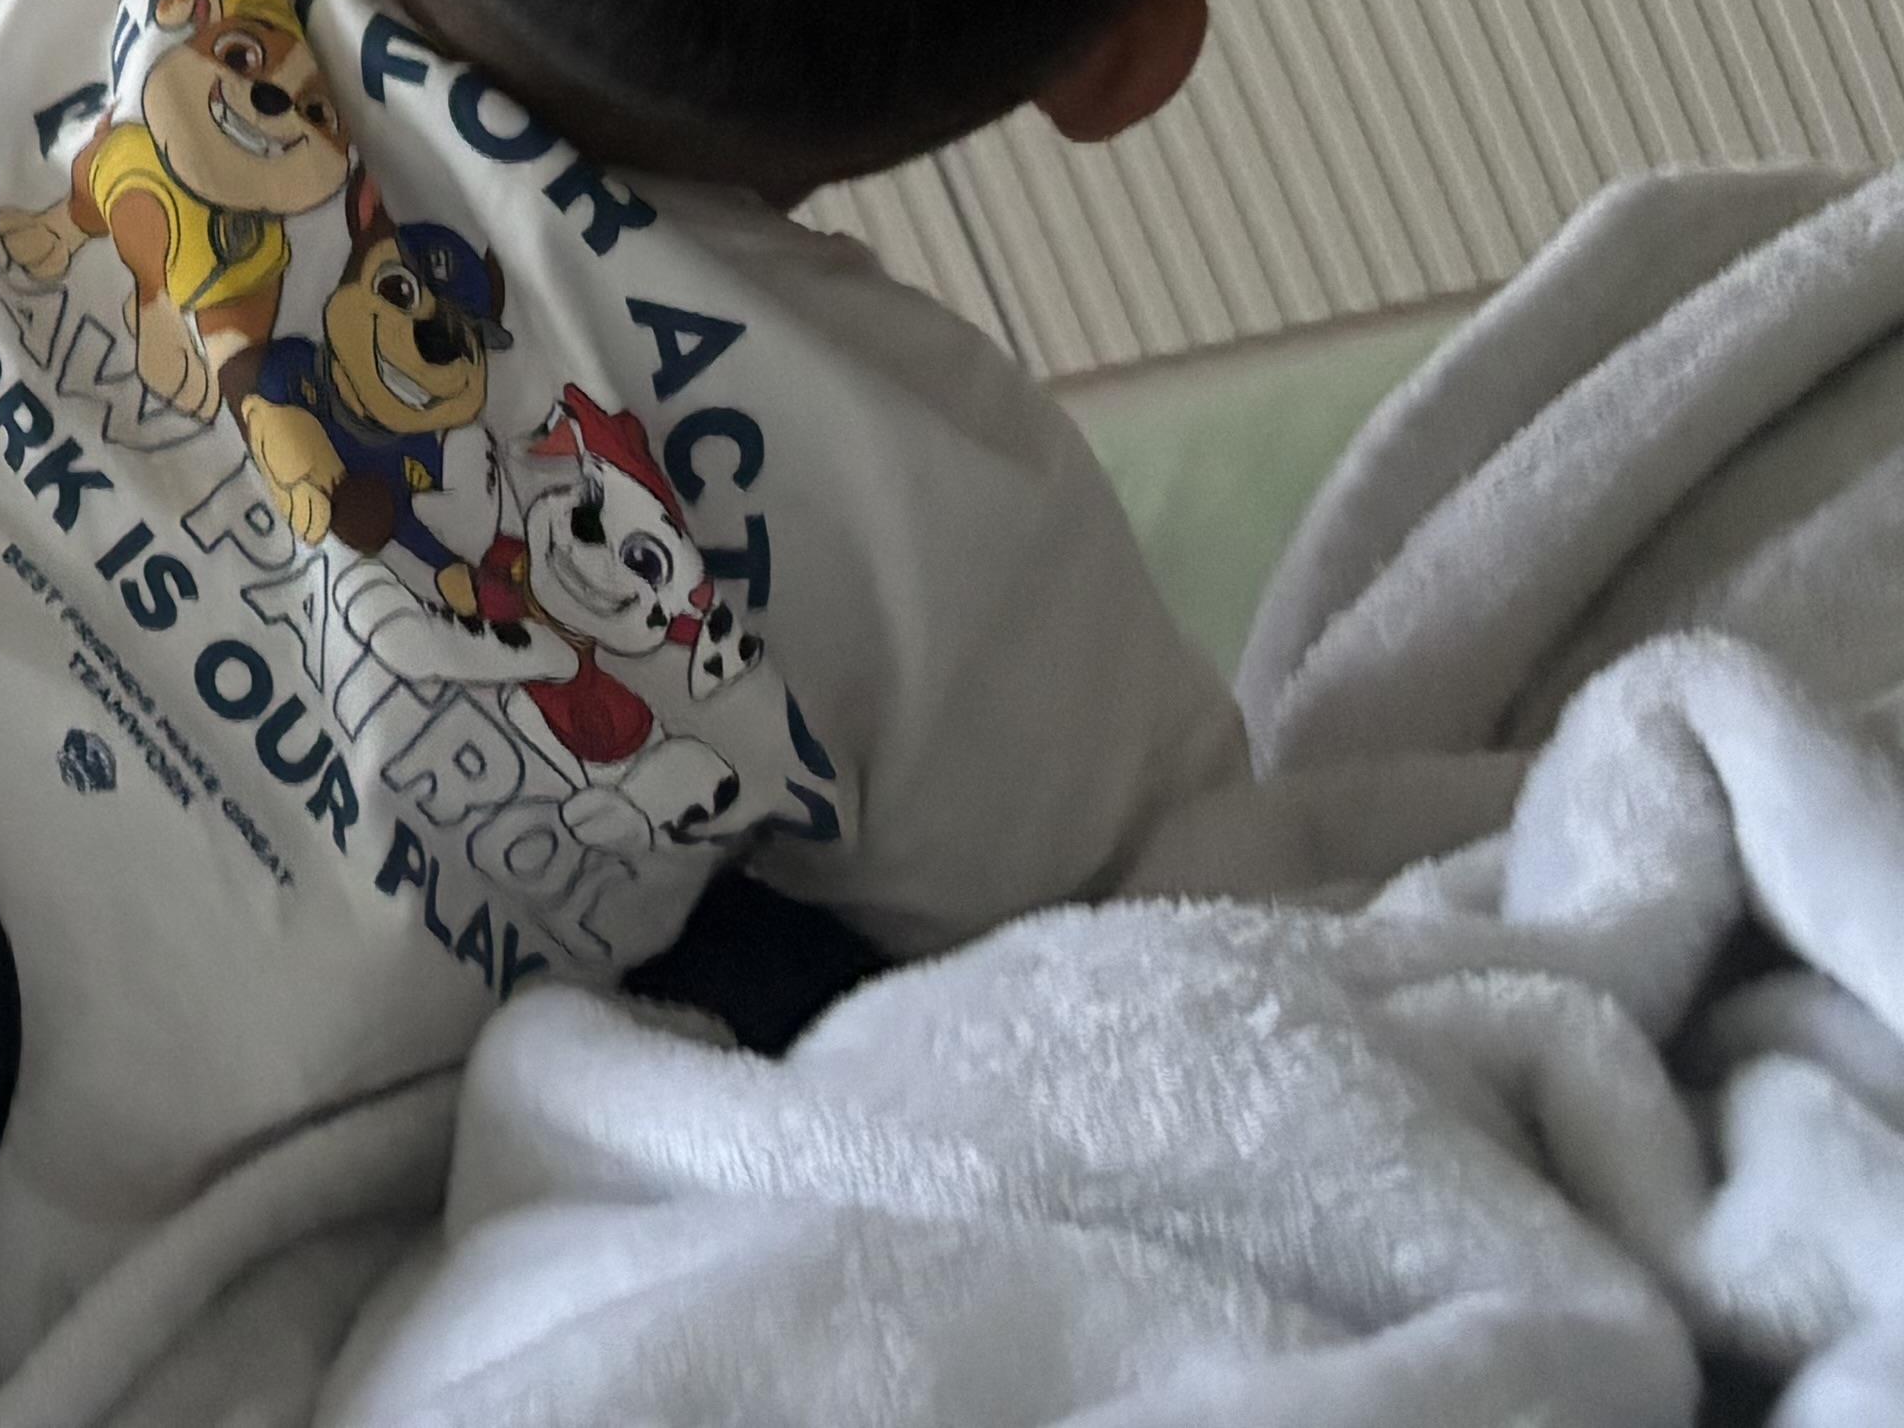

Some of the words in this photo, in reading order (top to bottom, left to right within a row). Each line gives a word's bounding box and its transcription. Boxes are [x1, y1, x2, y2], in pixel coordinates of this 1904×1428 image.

[360, 11, 657, 257] FOR
[3, 543, 63, 607] BEST
[60, 606, 155, 715] FRIENDS
[222, 797, 293, 886] GREAT
[70, 650, 193, 811] TEAMWORK
[95, 519, 198, 631] IS
[194, 640, 360, 856] OUR
[375, 818, 550, 1002] PLAY
